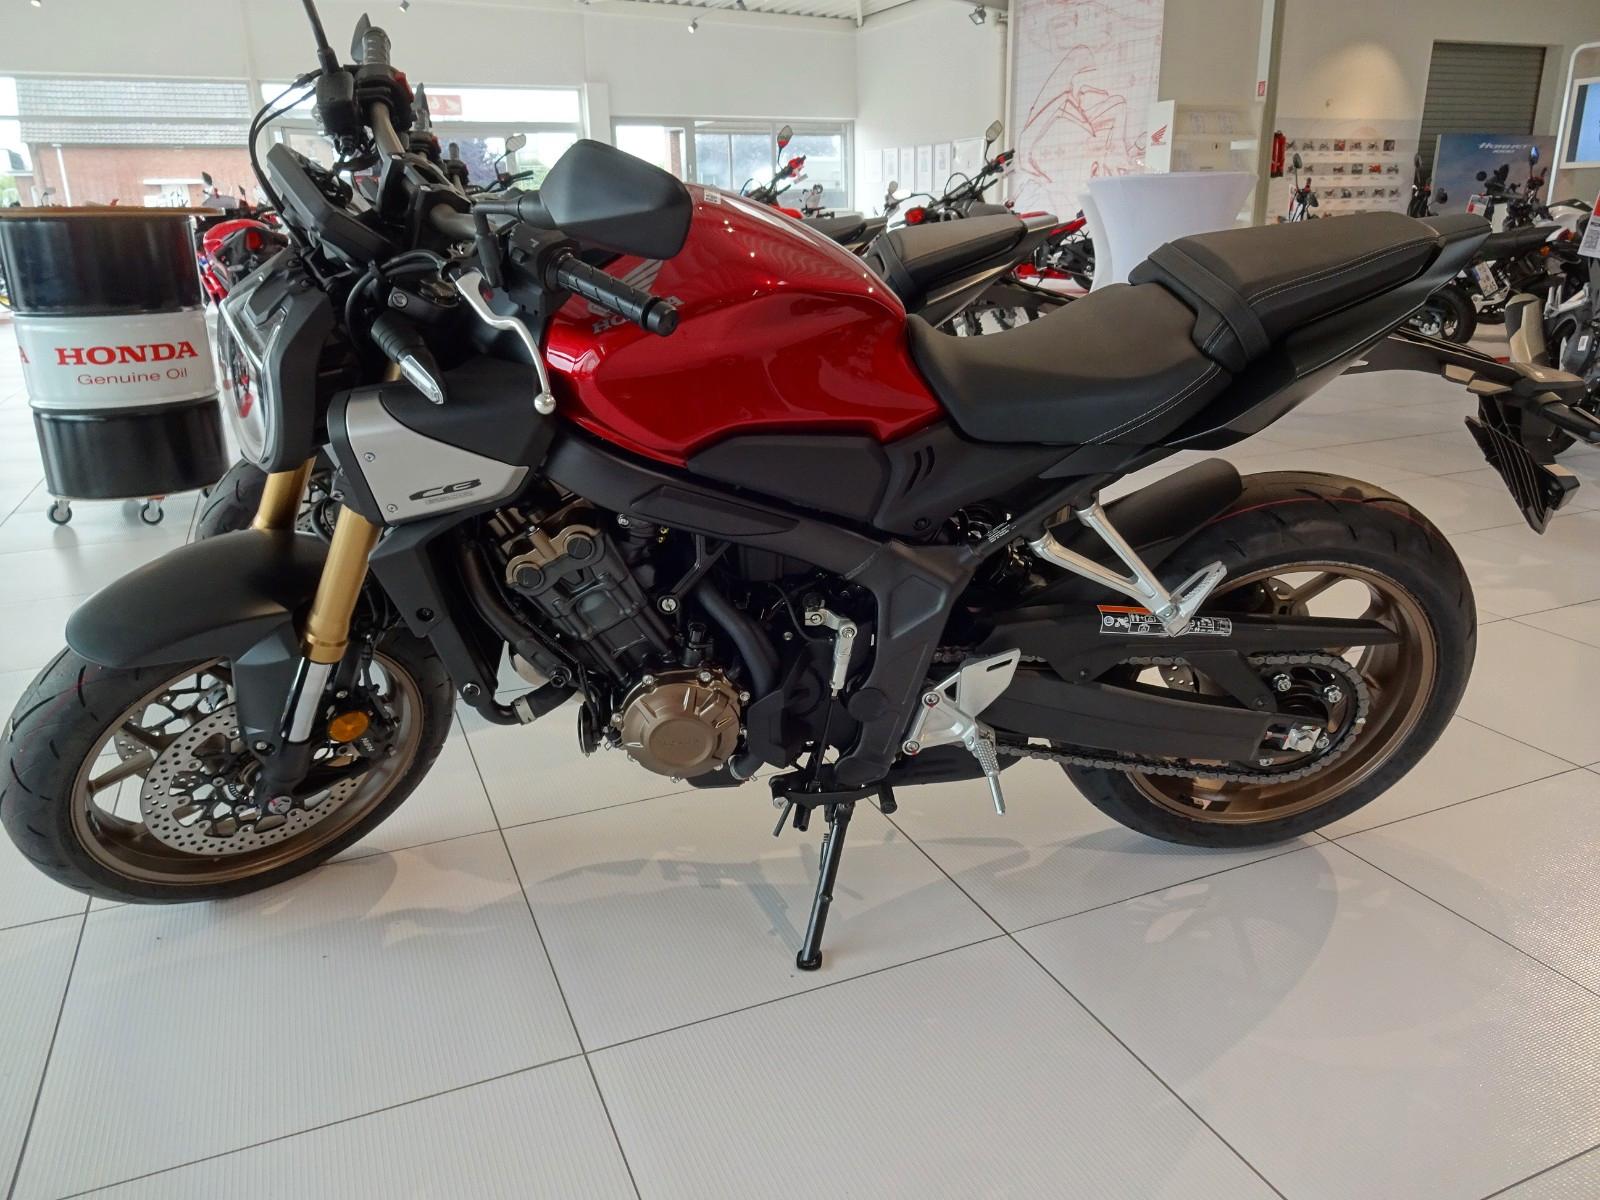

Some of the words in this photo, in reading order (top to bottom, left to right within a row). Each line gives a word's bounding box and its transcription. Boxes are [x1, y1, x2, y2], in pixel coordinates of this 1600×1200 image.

[55, 341, 200, 366] HONDA
[77, 371, 161, 386] Genuine
[166, 367, 188, 380] Oil
[409, 478, 482, 501] CB
